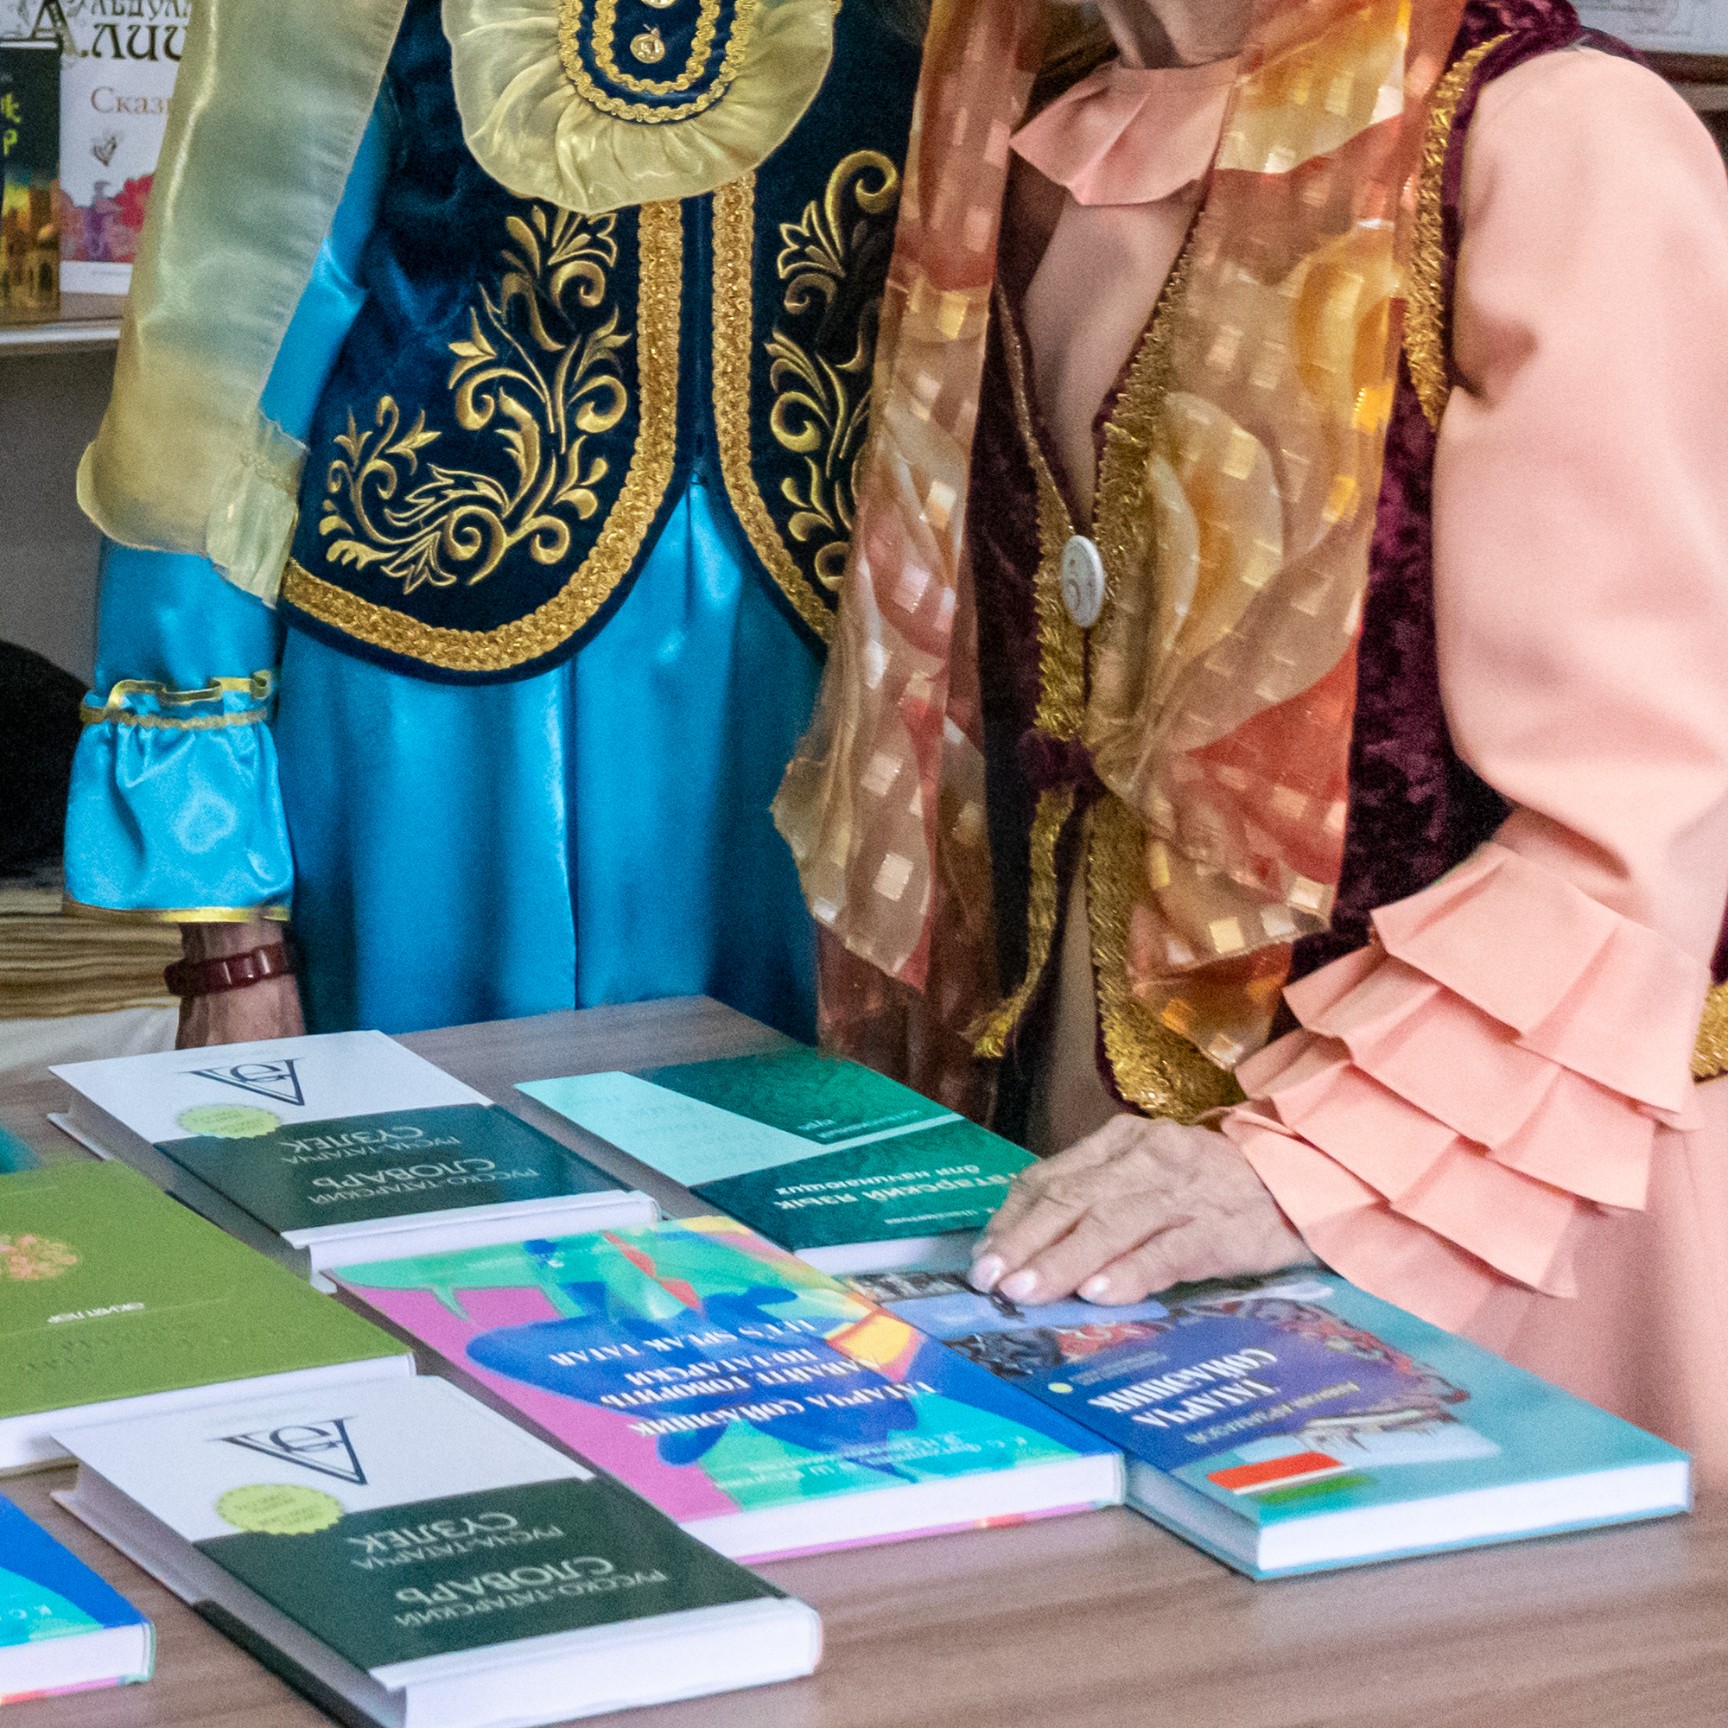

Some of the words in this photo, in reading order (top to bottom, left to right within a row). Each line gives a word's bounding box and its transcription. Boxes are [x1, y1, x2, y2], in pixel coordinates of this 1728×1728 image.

[90, 85, 172, 116] Сказ
[307, 1167, 541, 1205] РУССКО-ТАТАРСКИЙ
[312, 1157, 497, 1189] СЛОВАРЬ
[599, 1374, 751, 1409] ГОВОРИТЬ
[805, 1380, 937, 1409] ТАТАРЧА
[1131, 1379, 1282, 1429] ТАТАРЧА
[393, 1568, 669, 1629] РУССКО-ТАТАРСКИЙ
[395, 1555, 615, 1607] СЛОВАРЬ
